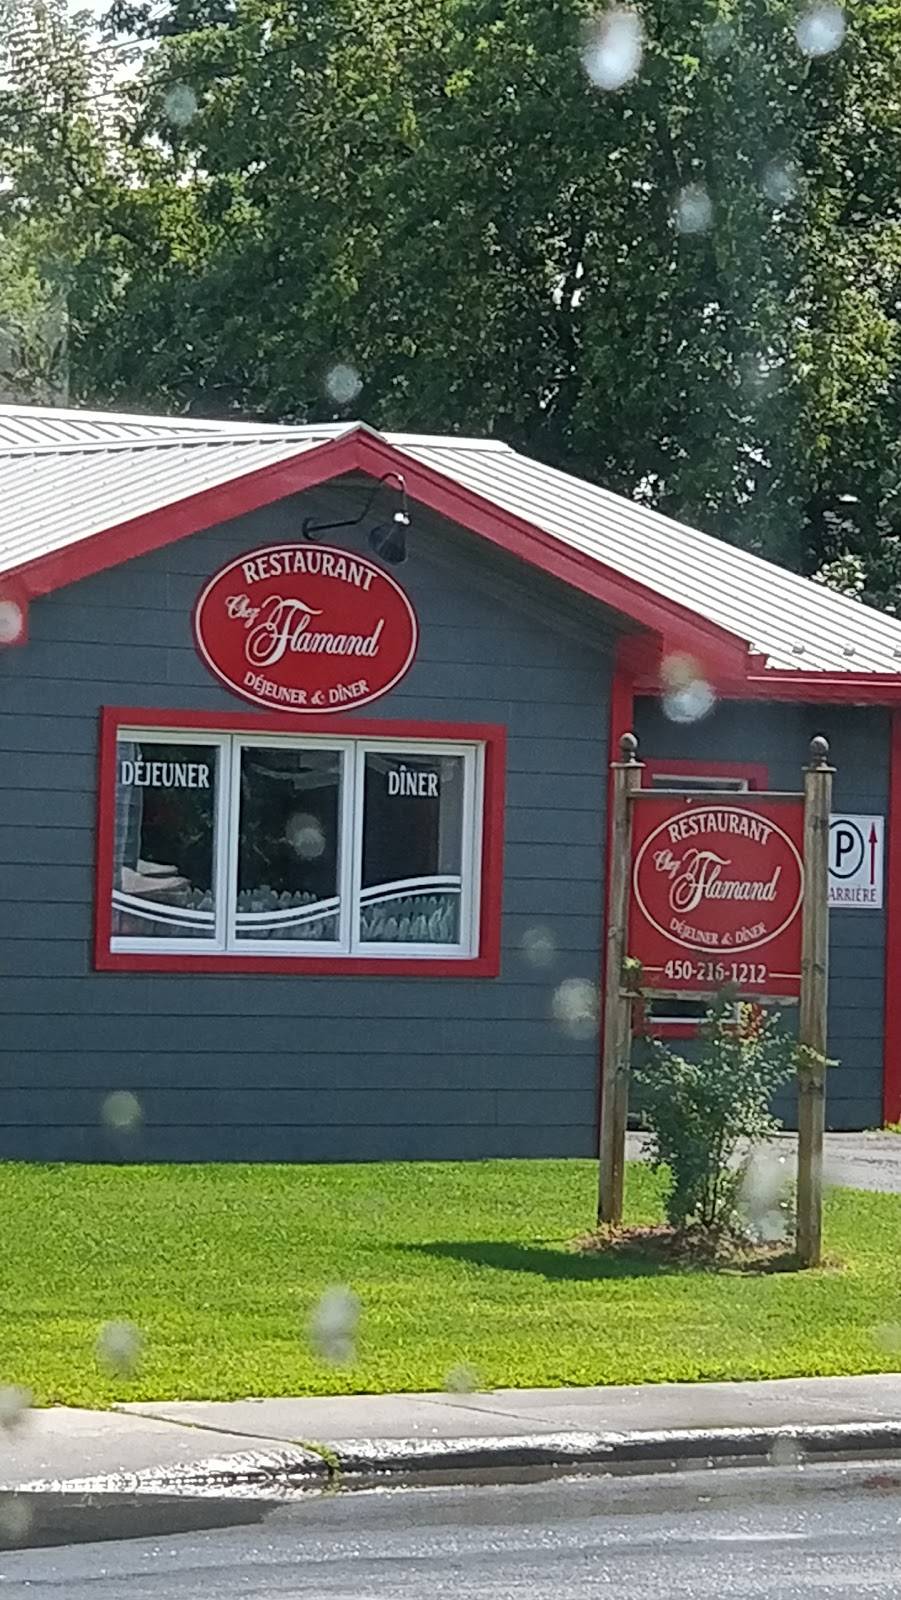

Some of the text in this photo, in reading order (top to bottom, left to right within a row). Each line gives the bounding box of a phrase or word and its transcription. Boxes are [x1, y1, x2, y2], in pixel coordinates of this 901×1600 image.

[242, 551, 378, 591] RESTAURANT
[225, 594, 384, 667] Chez Flamand
[244, 671, 370, 705] DÉJEUNER & DÎNER
[121, 754, 210, 789] DÉJEUNER
[388, 765, 438, 797] DÎNER
[667, 813, 773, 845] RESTAURANT
[836, 830, 854, 867] P
[653, 849, 781, 913] Chez Flamand
[669, 918, 768, 945] DÉJEUNER & DÎNER
[664, 960, 766, 983] 450-216-1212
